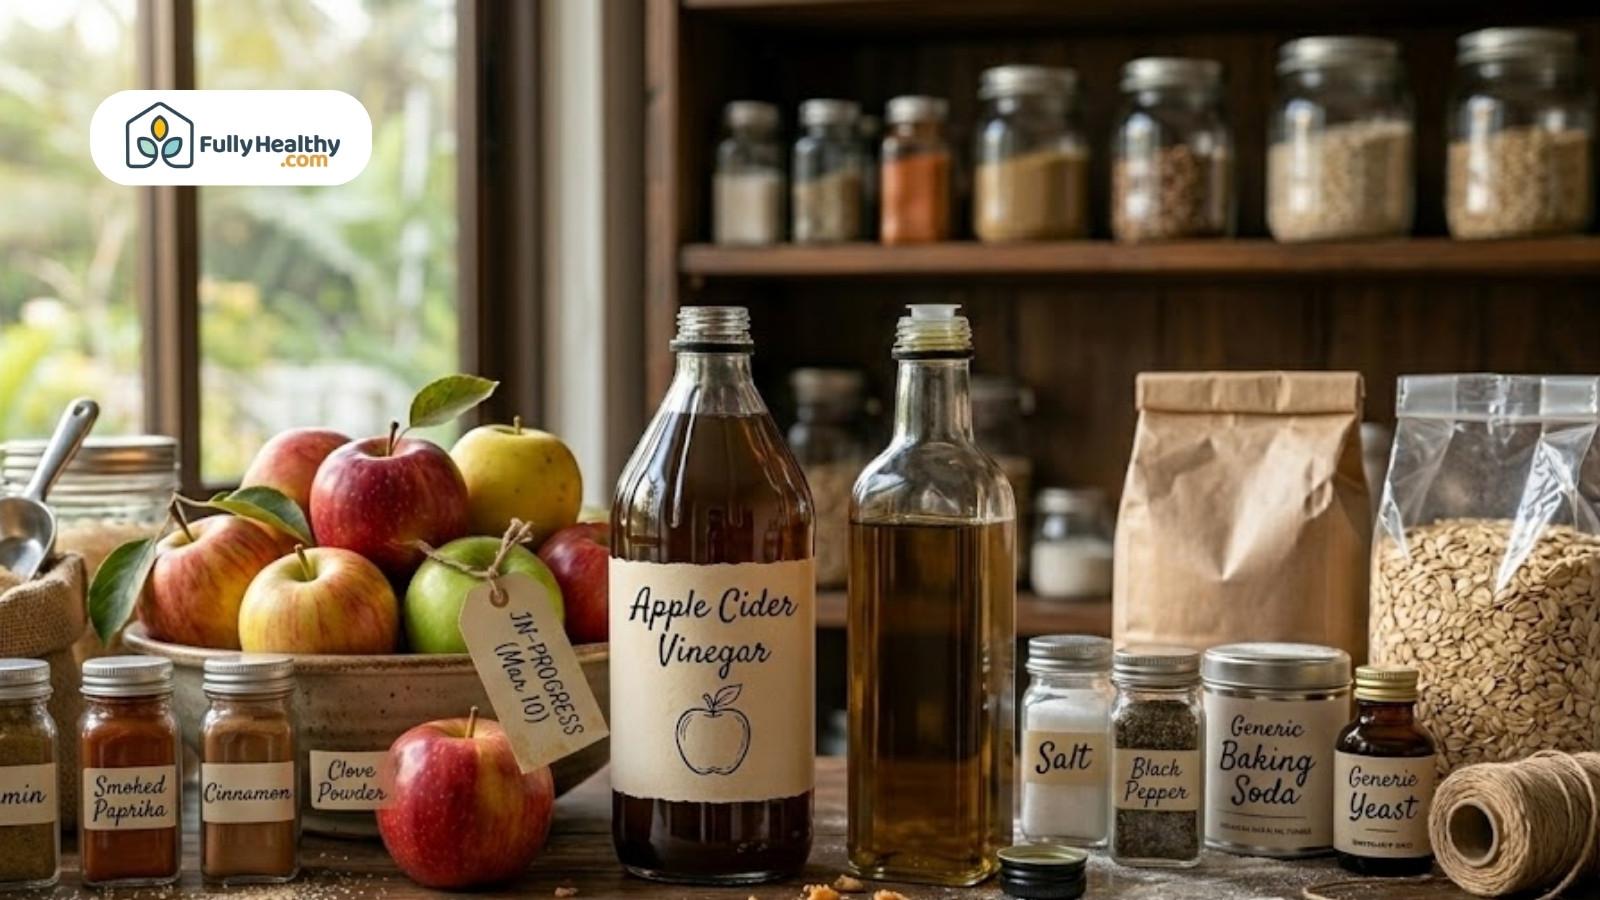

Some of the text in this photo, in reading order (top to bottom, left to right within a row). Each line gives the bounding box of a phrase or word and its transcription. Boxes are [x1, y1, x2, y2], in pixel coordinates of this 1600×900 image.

[629, 586, 799, 632] Apple Cider
[658, 633, 772, 680] Vinegar
[494, 642, 550, 723] (Mar 10)
[510, 612, 585, 735] IN-PROGRESS
[1230, 714, 1305, 738] Generic
[328, 759, 377, 781] Clove
[1035, 740, 1094, 775] Salt
[1219, 740, 1317, 788] Baking
[0, 783, 47, 805] min
[94, 774, 167, 798] Smoked
[203, 782, 293, 804] Cinnamon
[317, 781, 388, 803] Powder
[1123, 780, 1190, 808] Pepper
[1230, 774, 1302, 807] Soda
[92, 798, 168, 827] Paprika
[1348, 791, 1420, 822] Yeast
